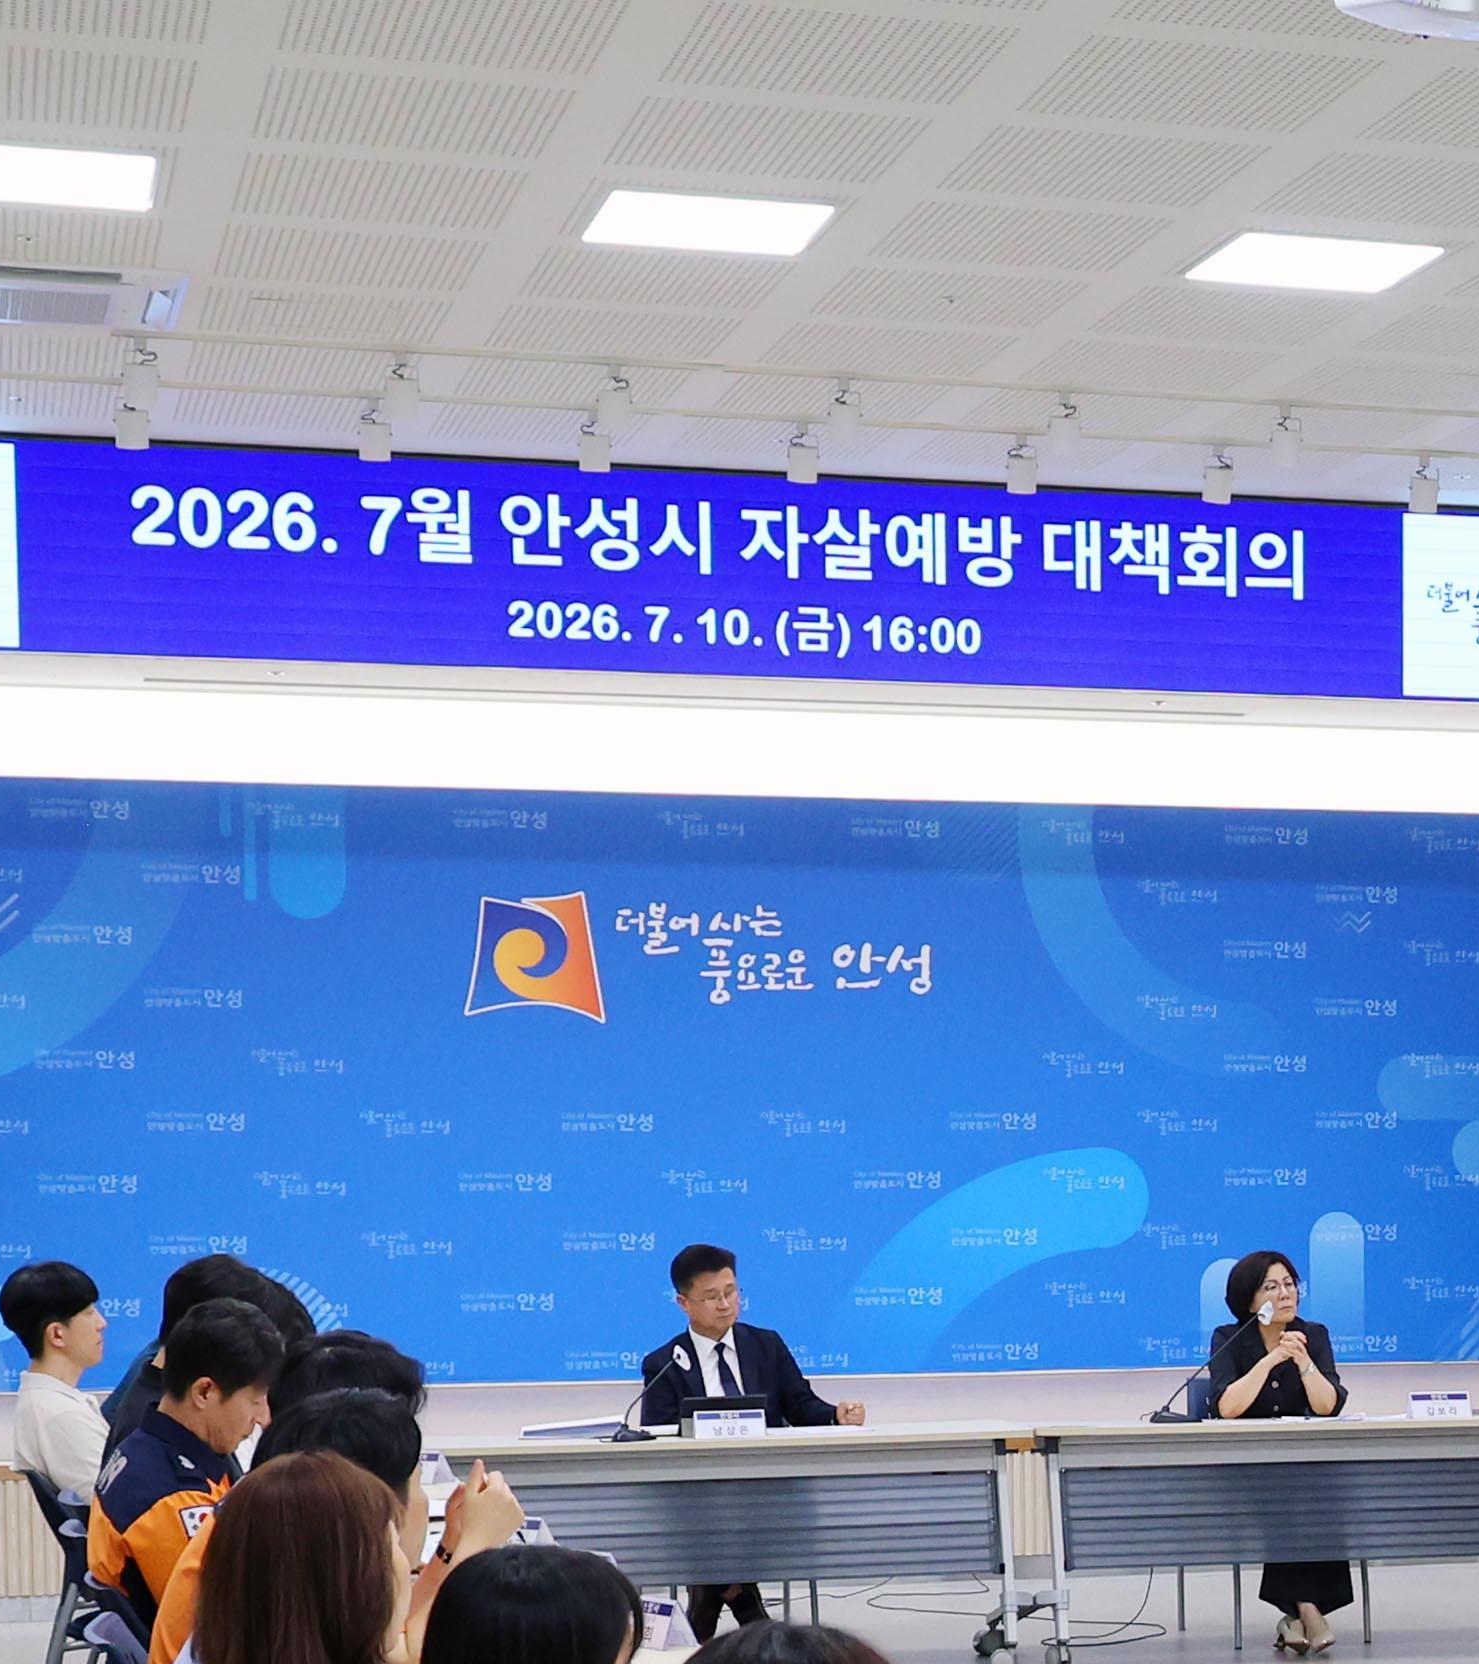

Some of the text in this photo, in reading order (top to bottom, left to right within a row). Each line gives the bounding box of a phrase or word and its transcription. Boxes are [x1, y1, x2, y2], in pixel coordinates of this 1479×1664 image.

[132, 486, 1306, 600] 2026. 7월 안성시 자살예방 대책회의
[508, 601, 981, 659] 2026. 7. 10. (금) 16:00
[89, 799, 130, 821] 안성
[509, 809, 548, 830] 안성
[904, 818, 940, 839] 안성
[1274, 826, 1308, 846] 안성
[201, 864, 241, 885] 안성
[1364, 885, 1398, 904] 안성
[92, 924, 133, 945] 안성
[616, 903, 783, 956] 더불어 사는
[1273, 940, 1307, 960] 안성
[700, 938, 931, 1004] 풍요로운 안성
[203, 988, 243, 1009] 안성
[1364, 998, 1397, 1017] 안성
[94, 1049, 135, 1070] 안성
[1273, 1054, 1307, 1073] 안성
[205, 1112, 245, 1132] 안성
[616, 1113, 654, 1132] 안성
[1001, 1112, 1037, 1131] 안성
[1364, 1111, 1397, 1129] 안성
[97, 1173, 138, 1194] 안성
[514, 1172, 552, 1192] 안성
[905, 1170, 941, 1189] 안성
[1273, 1167, 1307, 1186] 안성
[618, 1231, 655, 1251] 안성
[1002, 1227, 1038, 1246] 안성
[1364, 1223, 1397, 1241] 안성
[208, 1234, 248, 1255] 안성
[516, 1292, 554, 1312] 안성
[907, 1286, 942, 1306] 안성
[100, 1297, 141, 1318] 안성
[1003, 1341, 1038, 1361] 안성
[1364, 1333, 1398, 1353] 안성
